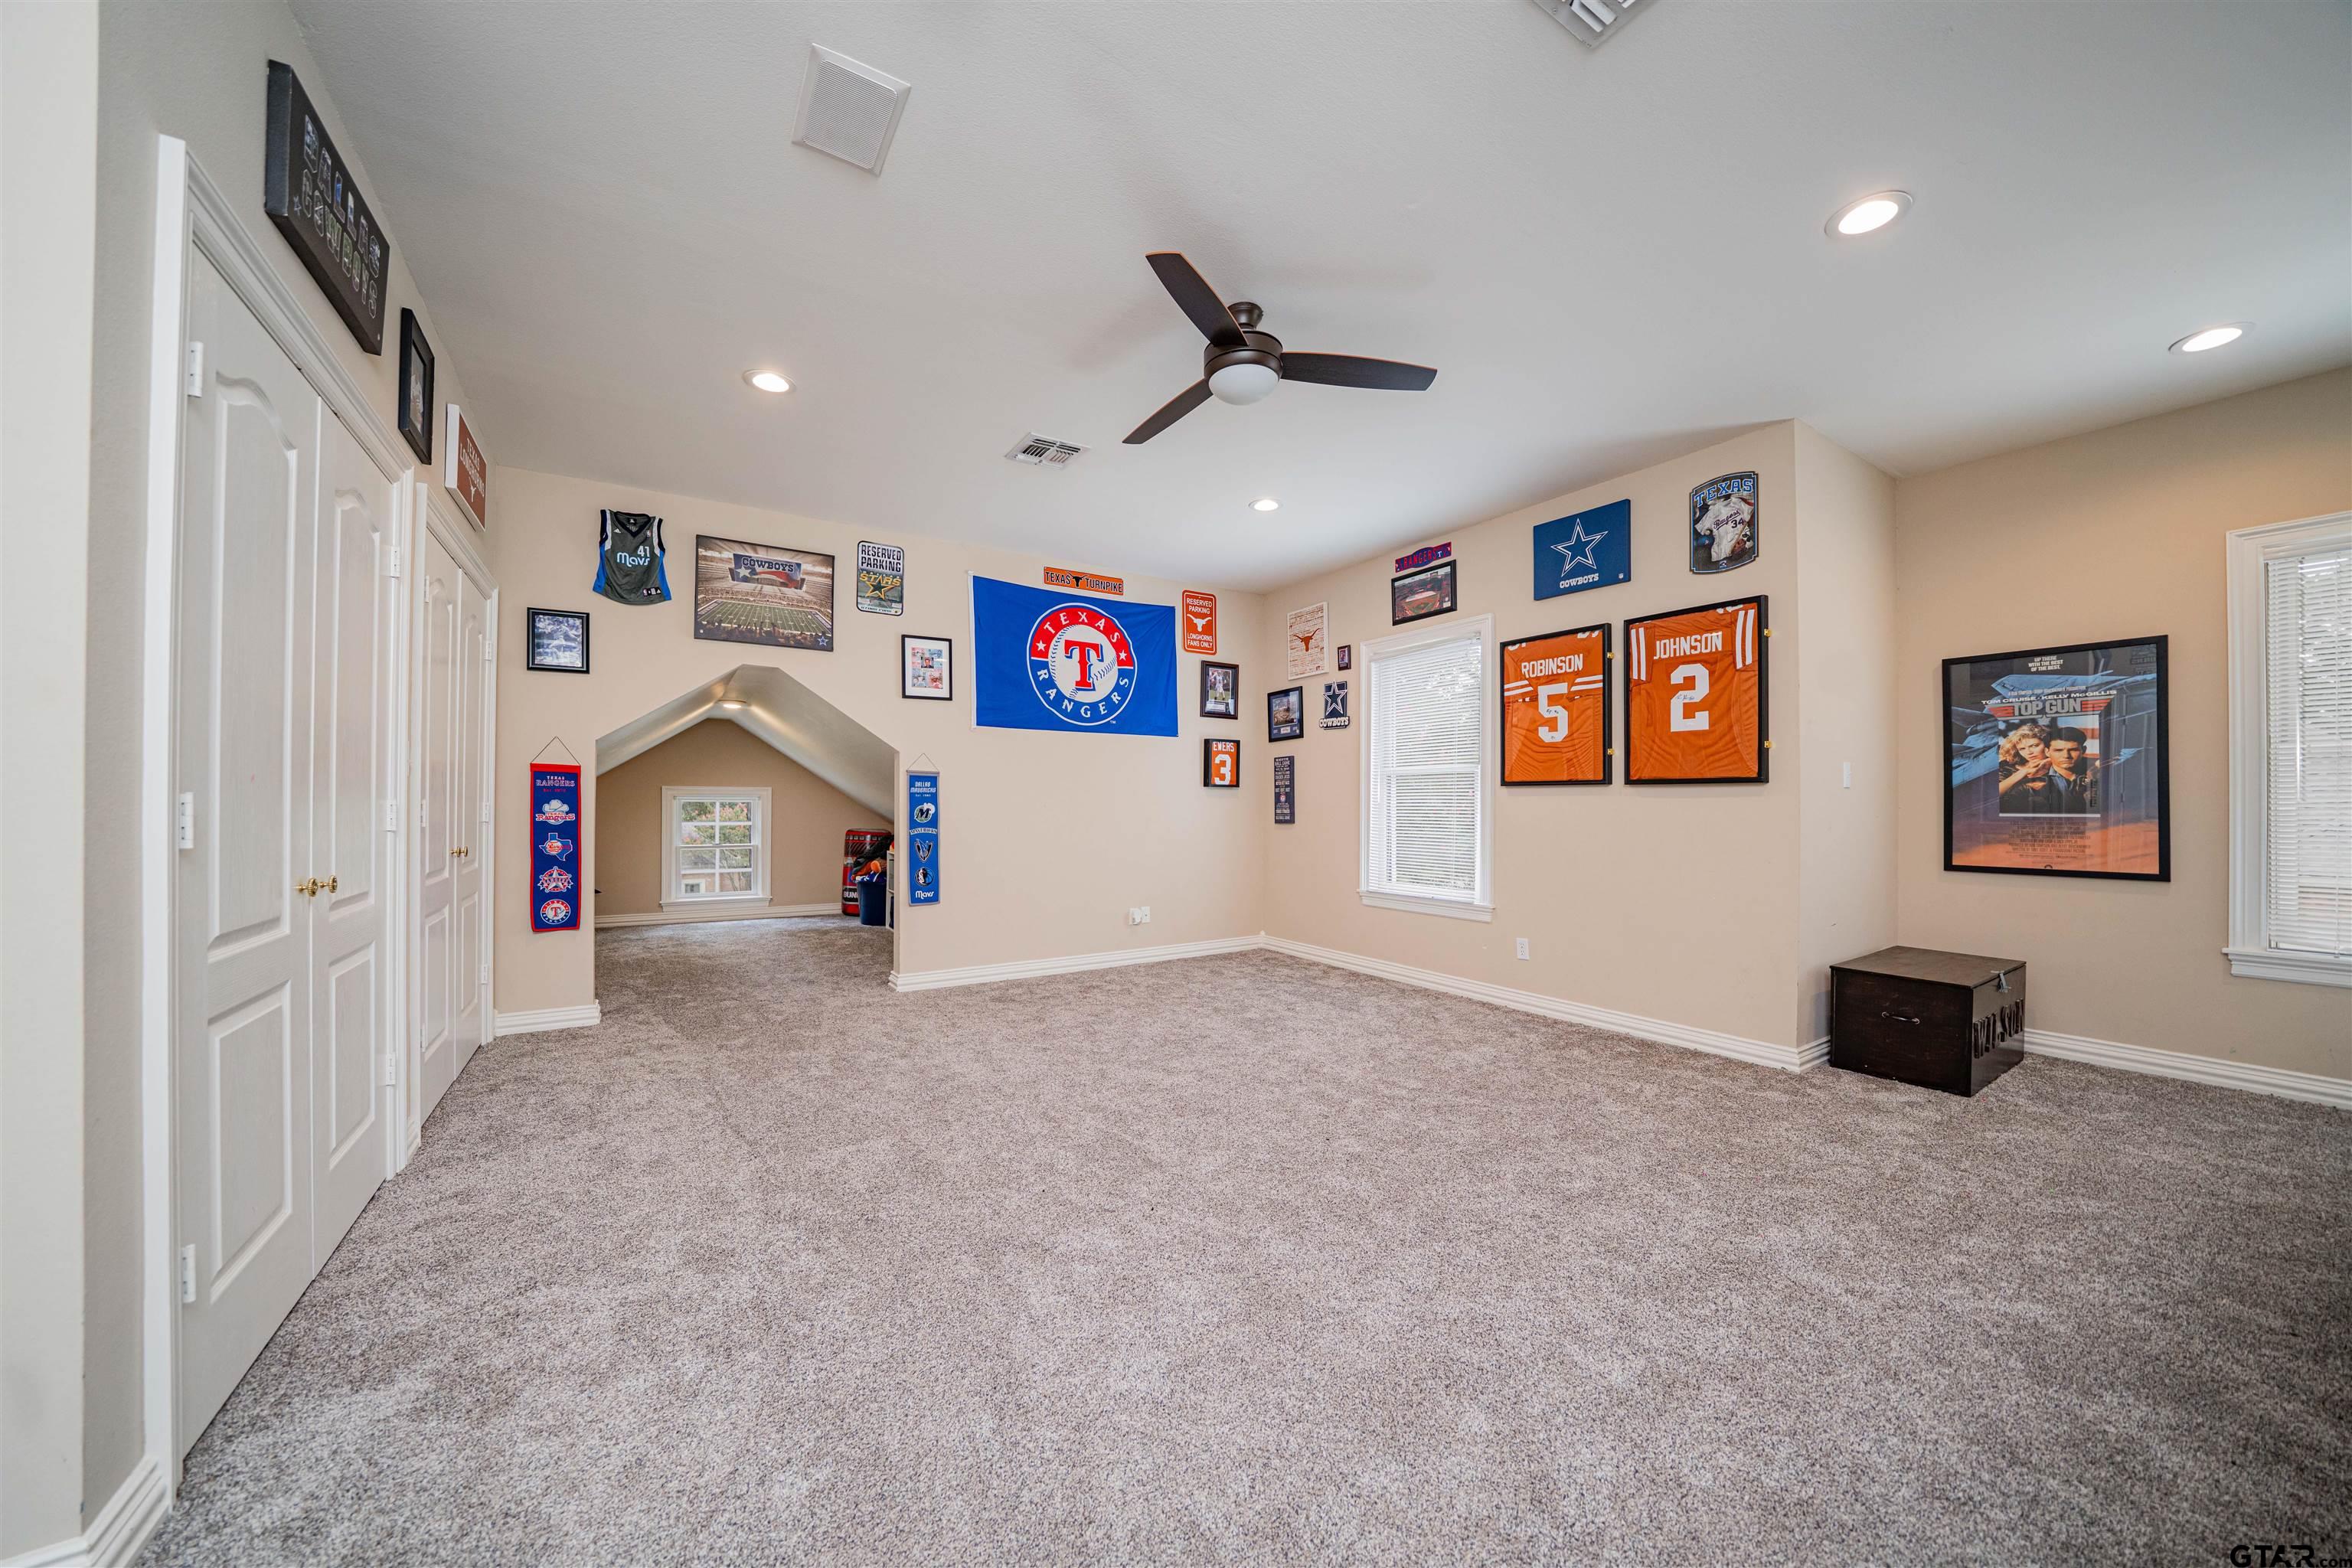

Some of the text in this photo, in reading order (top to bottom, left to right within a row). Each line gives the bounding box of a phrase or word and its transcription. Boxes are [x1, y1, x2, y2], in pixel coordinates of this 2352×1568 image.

[303, 114, 381, 278] DALLAS
[302, 168, 378, 319] COWBOYS
[466, 437, 481, 472] TEXAS
[459, 443, 485, 498] LONGHORNS
[1694, 479, 1753, 508] TEXAS
[1730, 518, 1744, 528] 34
[616, 552, 650, 567] Mavs
[637, 545, 650, 557] 41
[861, 544, 902, 561] RESERVED
[1403, 550, 1437, 568] RANGERS
[741, 557, 795, 573] COWBOYS
[861, 556, 901, 573] PARKING
[859, 573, 902, 586] STARS
[1045, 572, 1123, 593] TEXAS TURNPIKE
[1559, 573, 1599, 589] COWBOYS
[1186, 598, 1213, 607] RESERVED
[1188, 606, 1210, 614] PARKING
[1044, 611, 1121, 643] TEXAS
[1187, 632, 1213, 642] LONGHORNS
[1653, 630, 1723, 660] JOHNSON
[1521, 653, 1583, 678] ROBINSON
[1037, 668, 1130, 718] RANGERS
[1670, 663, 1710, 733] 2
[2070, 690, 2118, 698] McGILLIS
[1537, 682, 1568, 743] 5
[2014, 697, 2082, 717] TOP GUN
[1319, 717, 1349, 727] COWBOYS
[1213, 741, 1235, 753] EWERS
[1214, 753, 1232, 786] 3
[915, 890, 934, 900] Mavs
